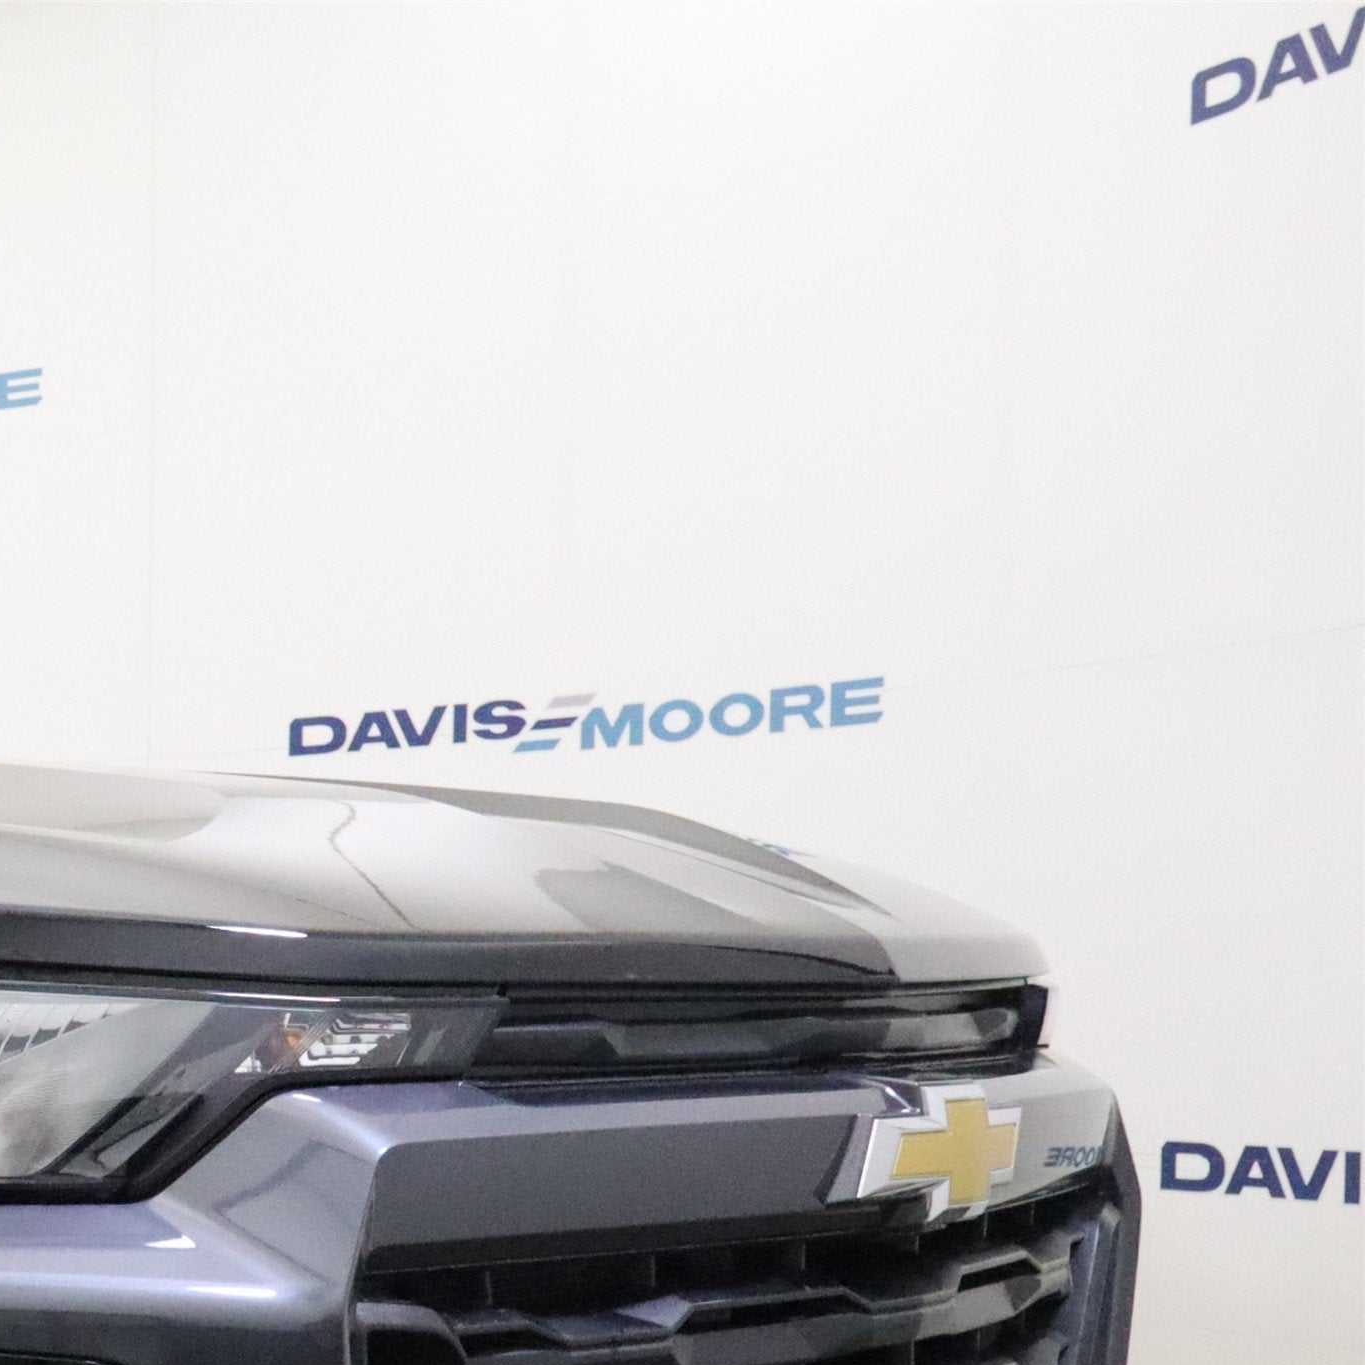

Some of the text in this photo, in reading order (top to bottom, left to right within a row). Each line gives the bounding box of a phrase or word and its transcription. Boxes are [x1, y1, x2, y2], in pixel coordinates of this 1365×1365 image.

[1190, 5, 1365, 126] DAV
[288, 676, 884, 757] DAVIS MOORE
[1160, 1140, 1362, 1204] DAVI
